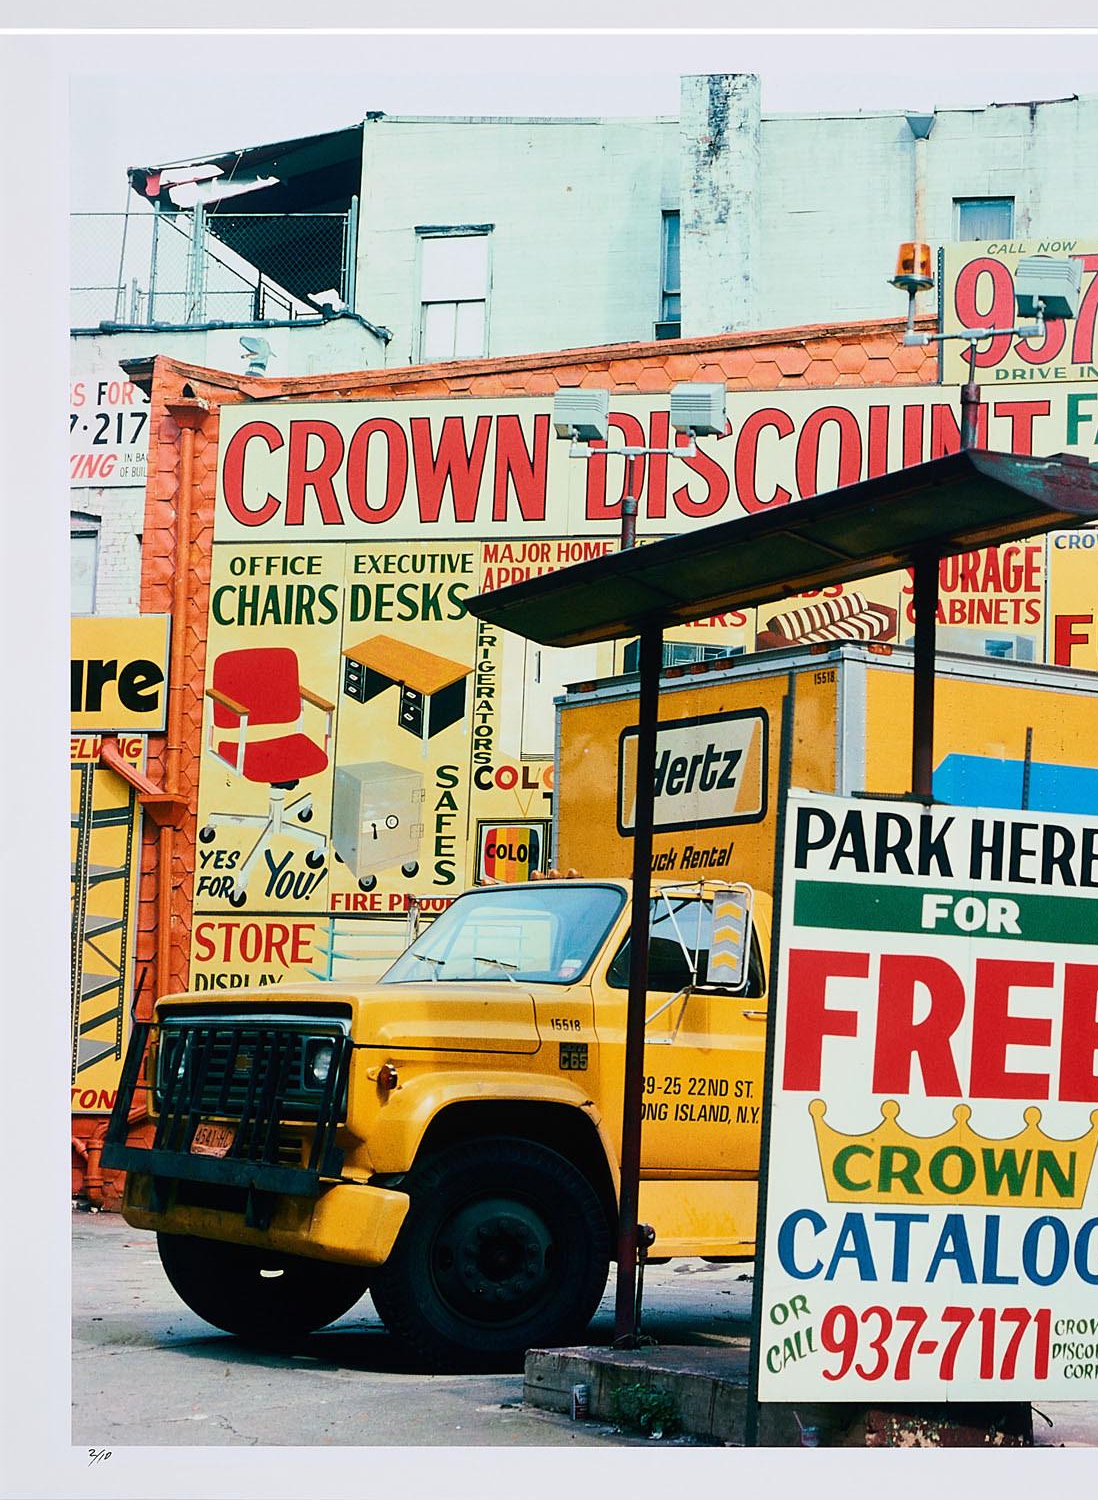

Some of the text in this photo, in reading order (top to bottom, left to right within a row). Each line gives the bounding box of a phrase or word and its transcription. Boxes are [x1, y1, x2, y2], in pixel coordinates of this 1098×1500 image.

[987, 242, 1026, 255] CALL
[1037, 240, 1078, 253] NOW
[995, 366, 1066, 381] DRIVE
[97, 381, 135, 406] FOR
[223, 414, 551, 527] CROWN
[229, 555, 322, 577] OFFICE
[353, 553, 474, 574] EXECUTIVE
[483, 542, 614, 564] MAJOR HOME
[211, 584, 340, 627] CHAIRS
[350, 582, 470, 623] DESKS
[814, 671, 836, 685] 15518
[433, 765, 459, 886] SAFES
[794, 806, 955, 878] PARK
[199, 850, 241, 870] YES
[680, 842, 734, 870] Rental
[196, 875, 234, 898] FOR
[265, 848, 329, 900] YOU!
[330, 893, 382, 911] FIRE
[921, 894, 1022, 934] FOR
[195, 922, 316, 968] STORE
[551, 1018, 581, 1031] 15518
[688, 1077, 729, 1097] 22ND
[735, 1080, 753, 1099] ST.
[674, 1103, 732, 1125] ISLAND,
[736, 1106, 760, 1124] N.Y.
[832, 1144, 1077, 1198] CROWN
[769, 1295, 811, 1326] OR
[766, 1327, 818, 1374] CALL
[820, 1305, 1052, 1381] 937-7171
